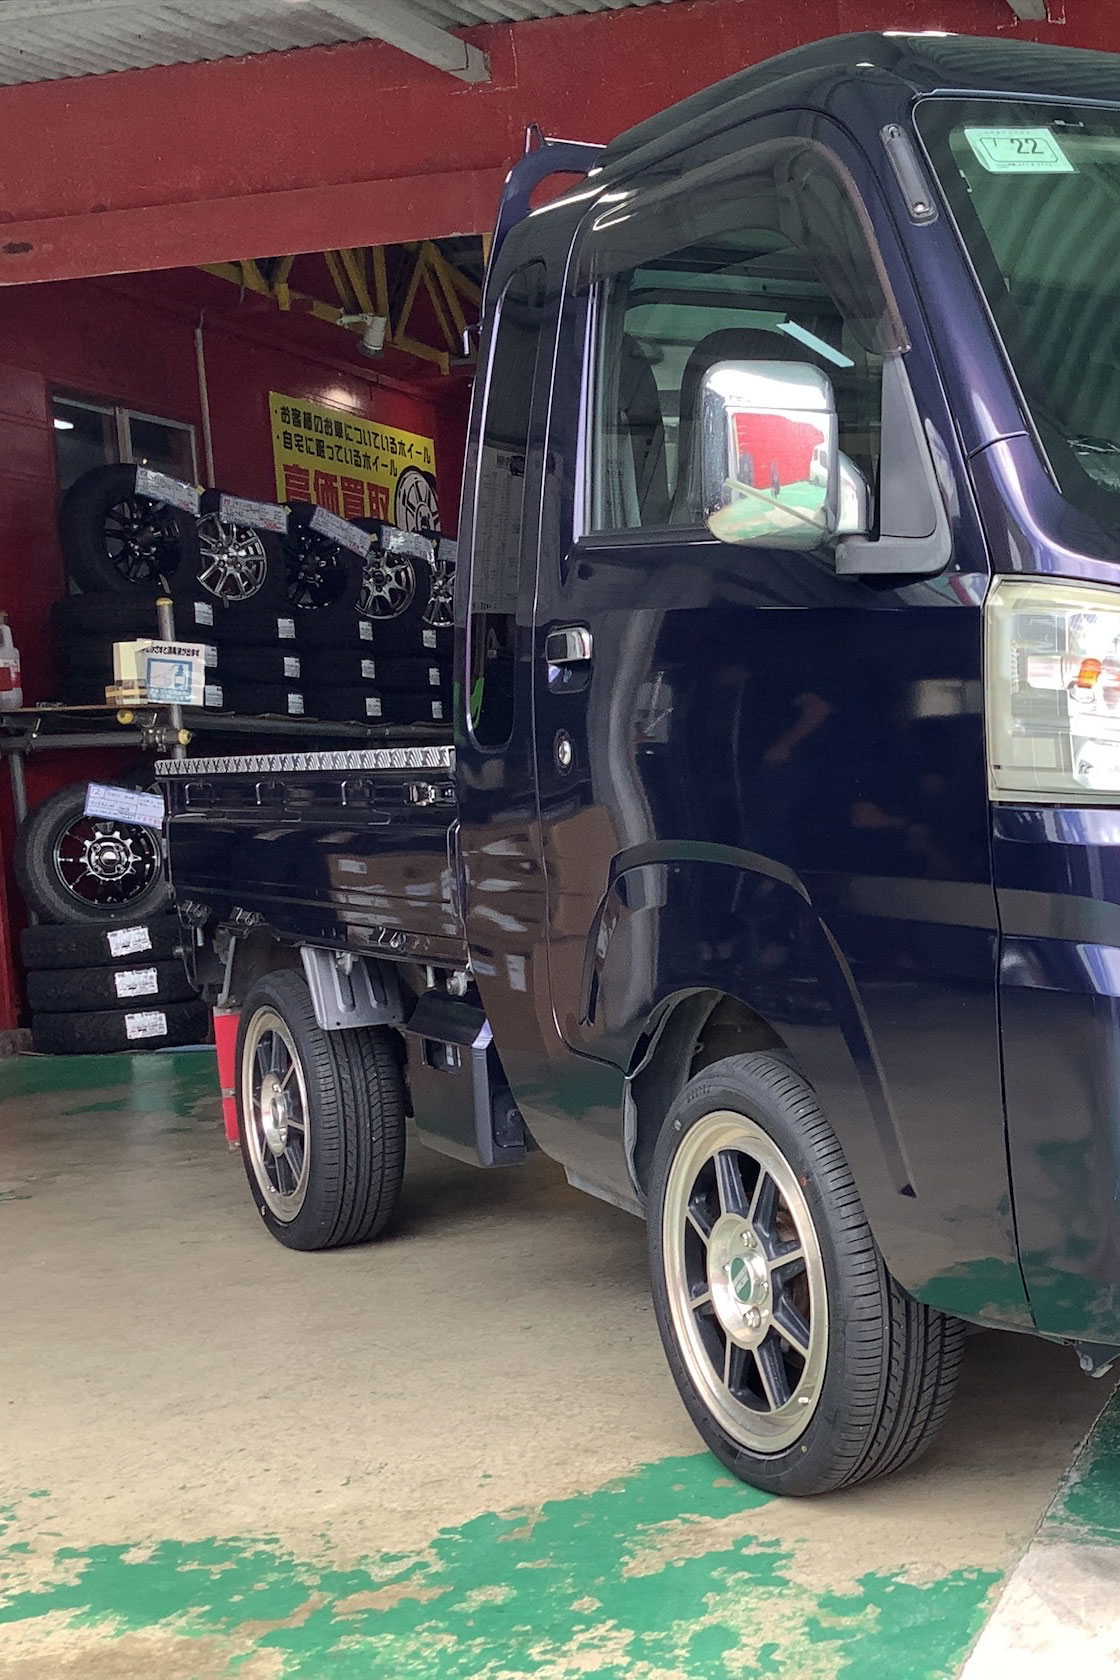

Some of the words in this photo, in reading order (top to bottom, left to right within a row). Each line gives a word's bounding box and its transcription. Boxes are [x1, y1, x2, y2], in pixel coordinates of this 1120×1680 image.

[1010, 137, 1045, 155] 22
[282, 430, 399, 477] 自宅に眠っているホイール
[283, 463, 390, 524] 高価買取
